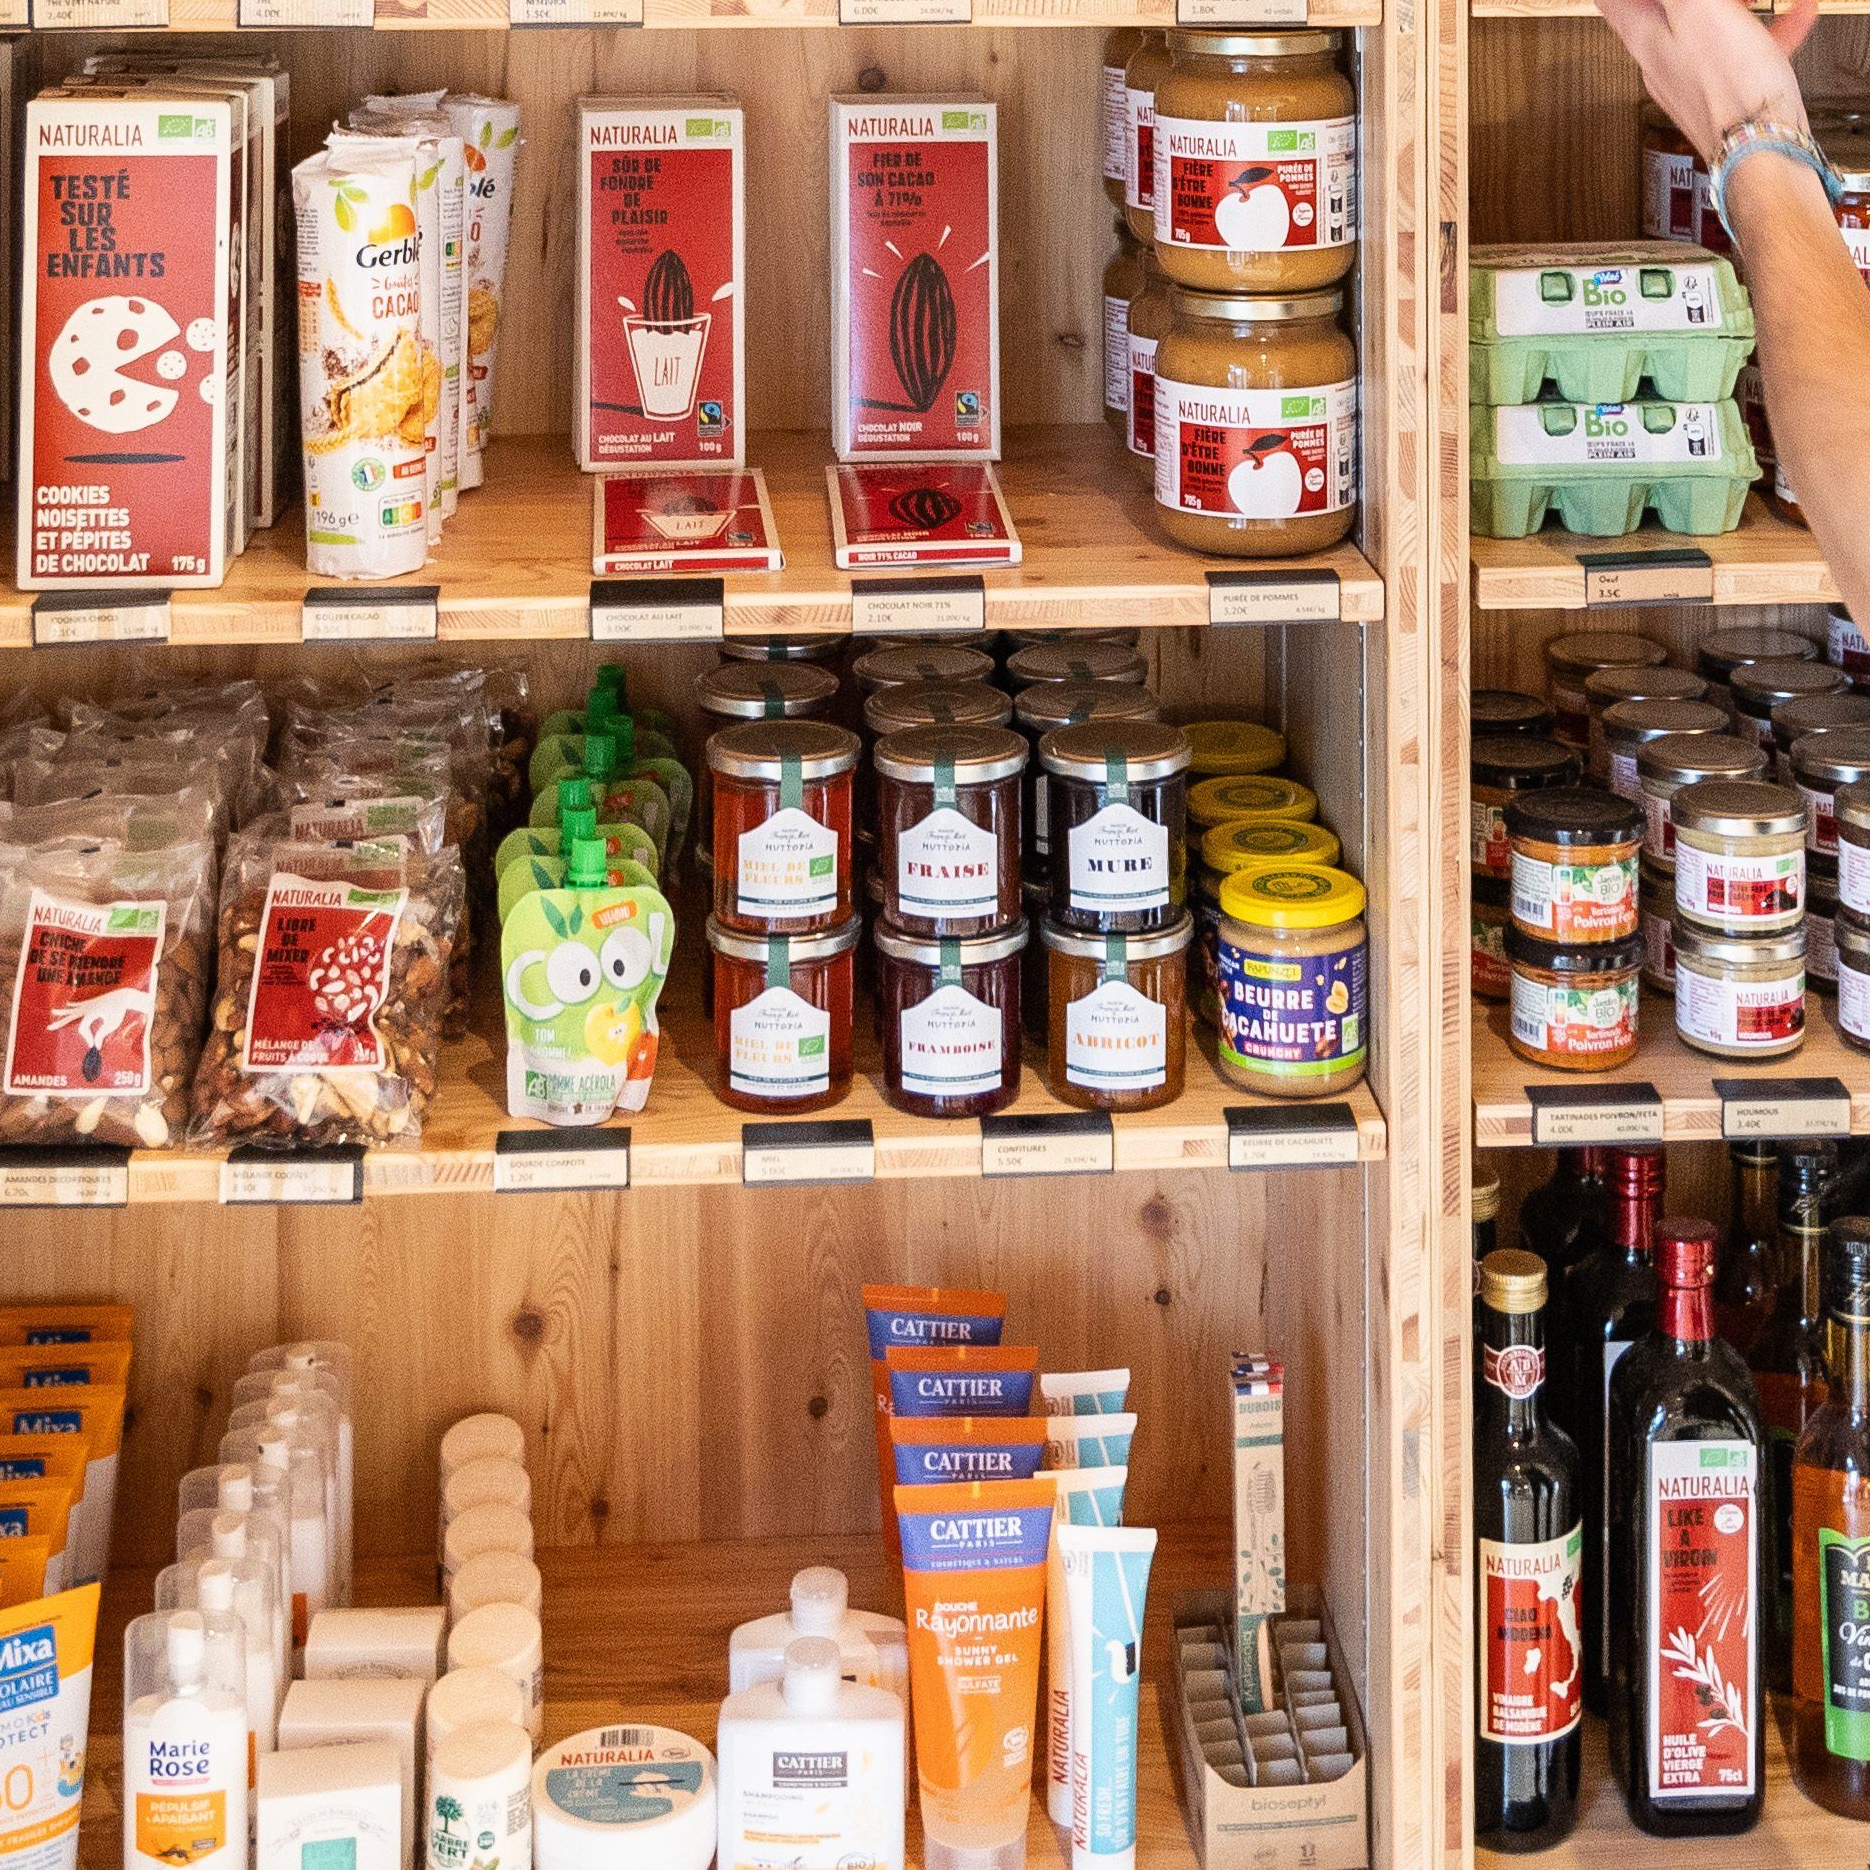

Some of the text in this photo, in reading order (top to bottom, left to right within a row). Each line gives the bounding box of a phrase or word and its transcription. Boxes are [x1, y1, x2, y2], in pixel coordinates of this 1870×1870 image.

[853, 5, 879, 15] 6.00€
[848, 117, 935, 138] NATURALIA
[612, 210, 668, 225] PLAISIR
[48, 253, 165, 278] ENFANTS
[654, 355, 680, 387] LAIT
[37, 485, 110, 505] COOKIES
[37, 507, 129, 527] NOISETTES
[62, 552, 150, 572] CHOCOLAT
[1598, 574, 1619, 584] Oeuf
[1598, 588, 1620, 598] 3.5€
[866, 600, 951, 611] CHOCOLAT NOIR 71%
[906, 861, 989, 879] FRAISE
[1088, 856, 1152, 873] MURE
[271, 888, 344, 908] NATURALIA
[1234, 980, 1314, 1010] BEURRE
[1262, 1010, 1279, 1021] DE
[1222, 1008, 1336, 1044] CACAHUETE
[908, 1039, 996, 1055] FRAMBOISE
[1074, 1032, 1160, 1051] ABRICOT
[12, 1074, 68, 1089] AMANDES
[1549, 1110, 1659, 1122] TARTINADES POIVRON/FETA
[1736, 1108, 1779, 1118] HOUMOUS
[997, 1144, 1047, 1154] CONFITURES
[1658, 1475, 1750, 1498] NATURALIA
[931, 1517, 1023, 1540] CATTIER
[916, 1604, 1038, 1635] Rayonnante
[1663, 1734, 1696, 1746] HUILE
[149, 1740, 210, 1759] Marie
[561, 1750, 655, 1766] NATURALIA
[1663, 1746, 1706, 1758] D'OLIVE
[149, 1758, 210, 1778] Rose
[1663, 1759, 1703, 1770] VIERGE
[1663, 1770, 1700, 1783] EXTRA
[1719, 1769, 1742, 1782] 75cl
[1251, 1795, 1327, 1814] bioseptyl
